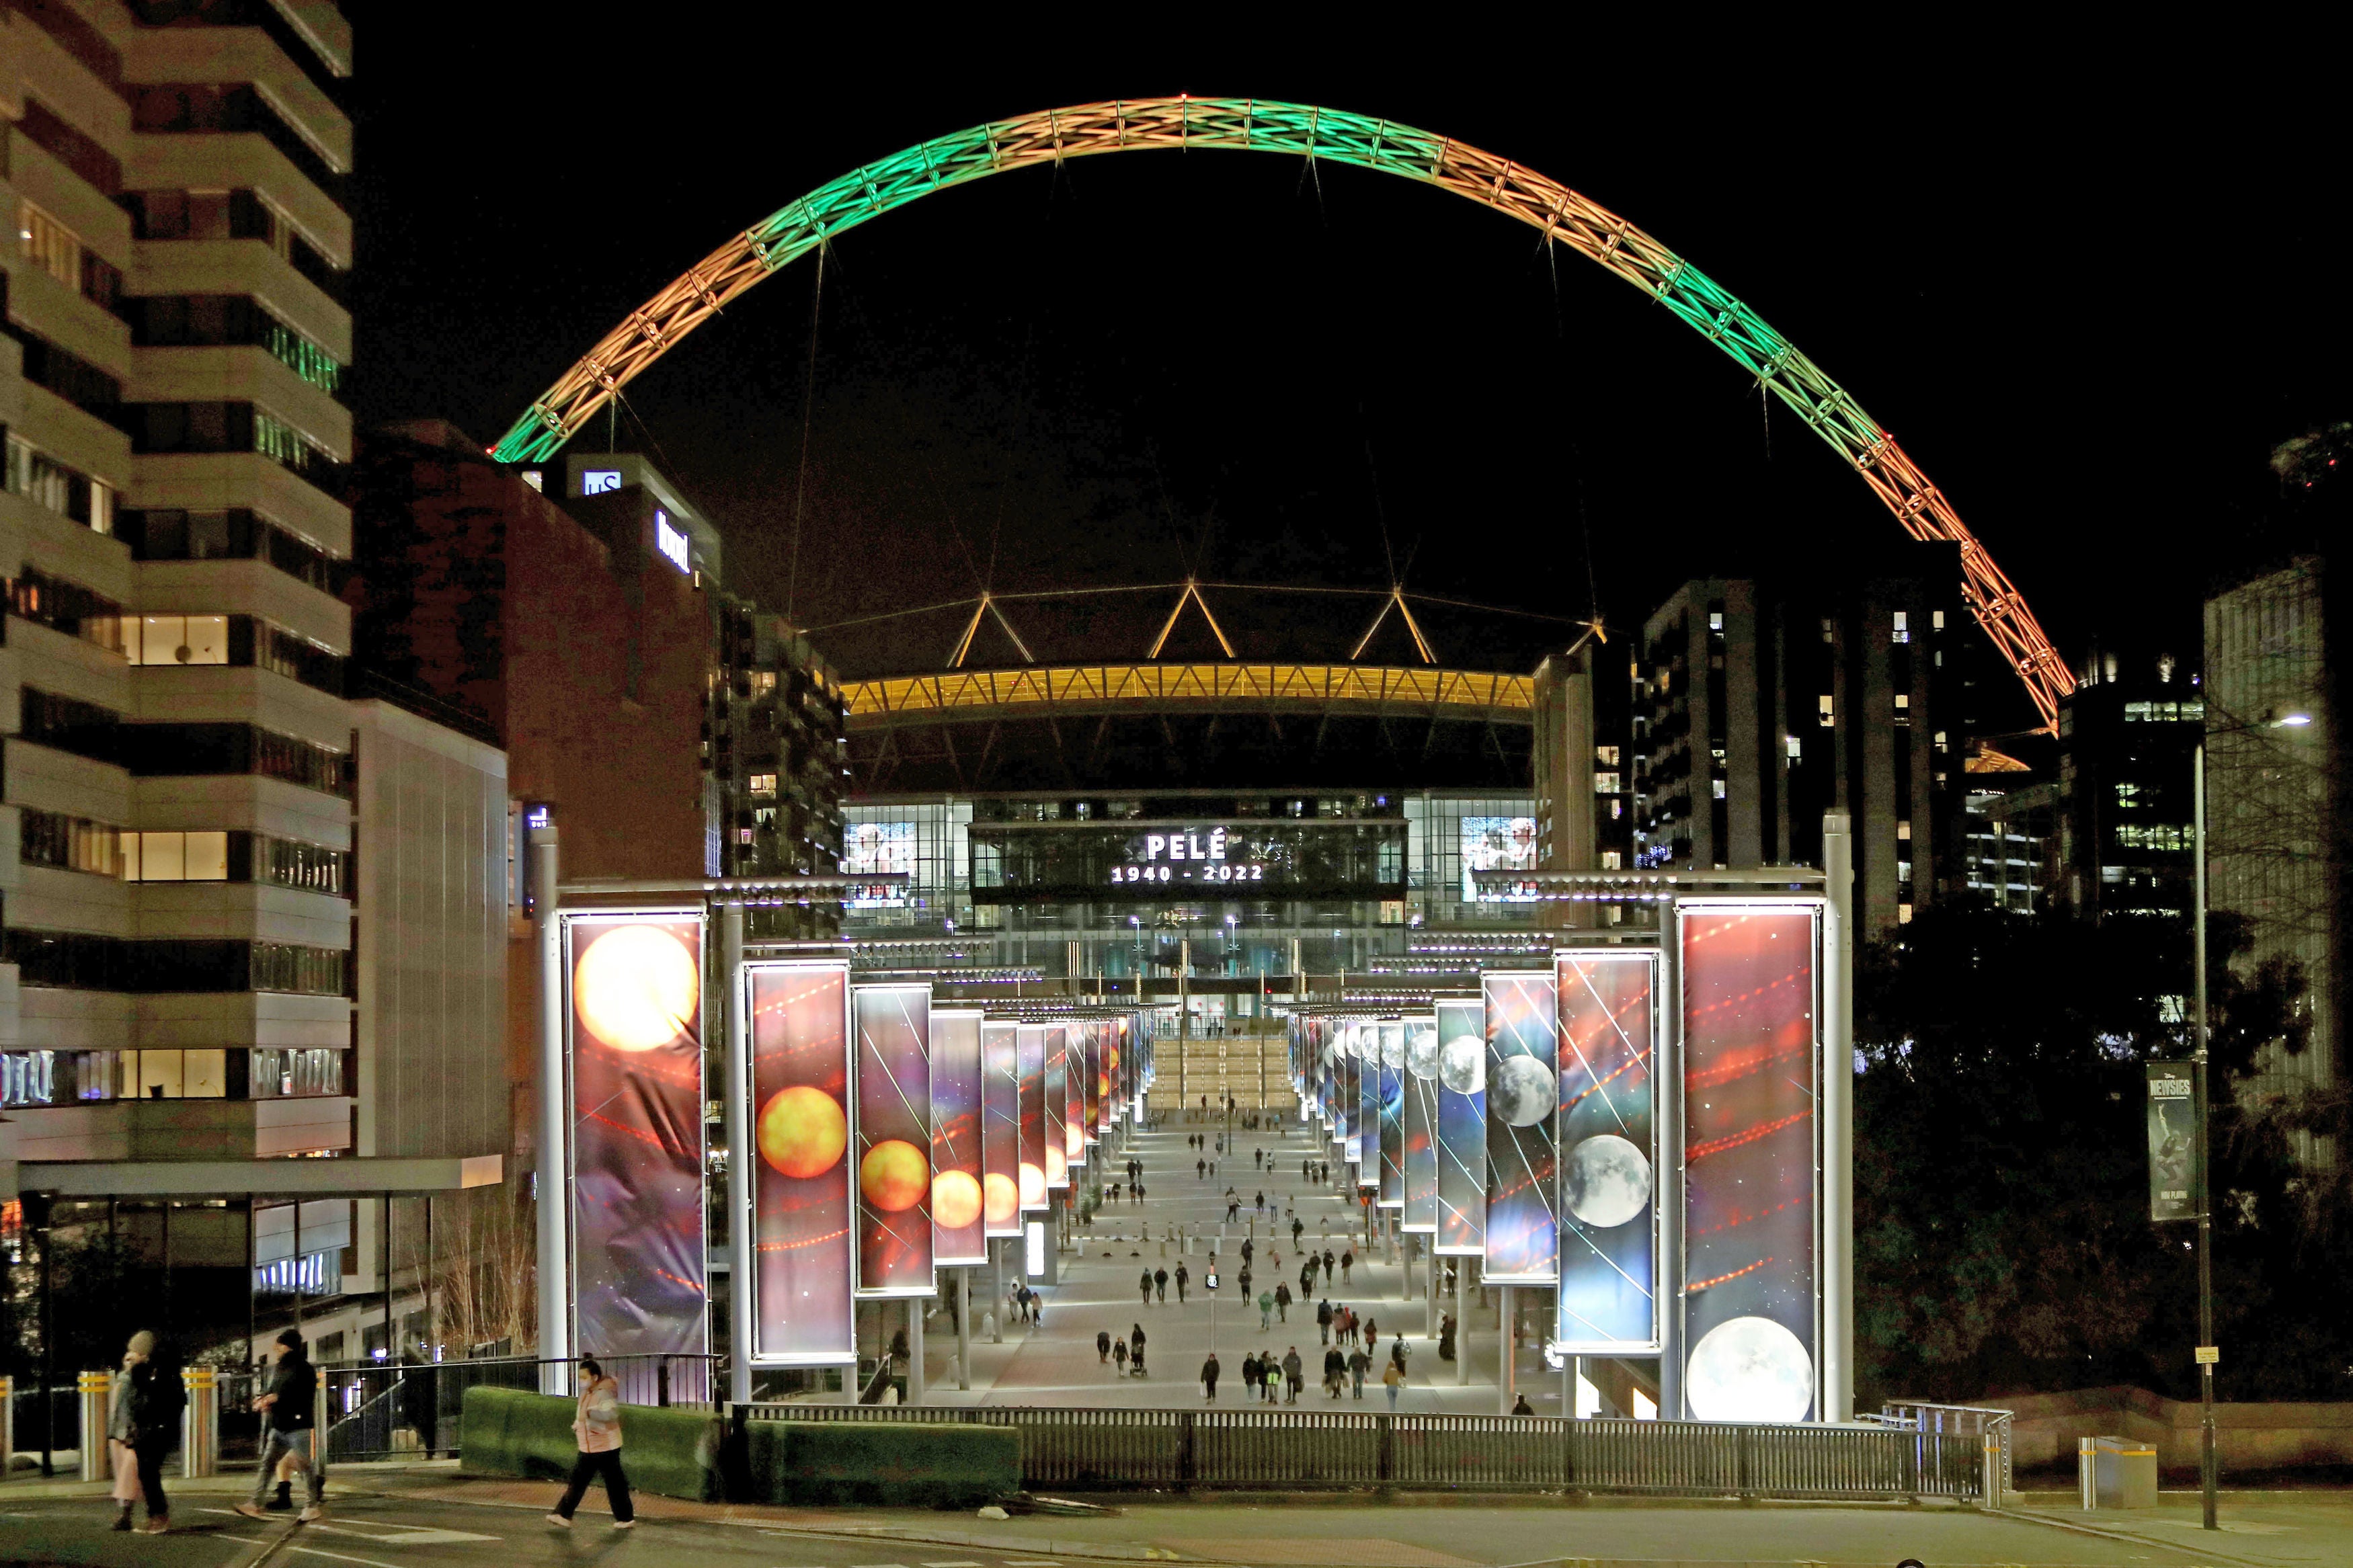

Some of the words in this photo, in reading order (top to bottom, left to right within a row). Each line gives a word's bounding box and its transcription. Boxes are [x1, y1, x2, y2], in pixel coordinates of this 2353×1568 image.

[1147, 827, 1226, 860] PELÉ
[1112, 866, 1172, 882] 1940
[1203, 865, 1263, 880] 2022
[2150, 1079, 2191, 1096] NEWSIES
